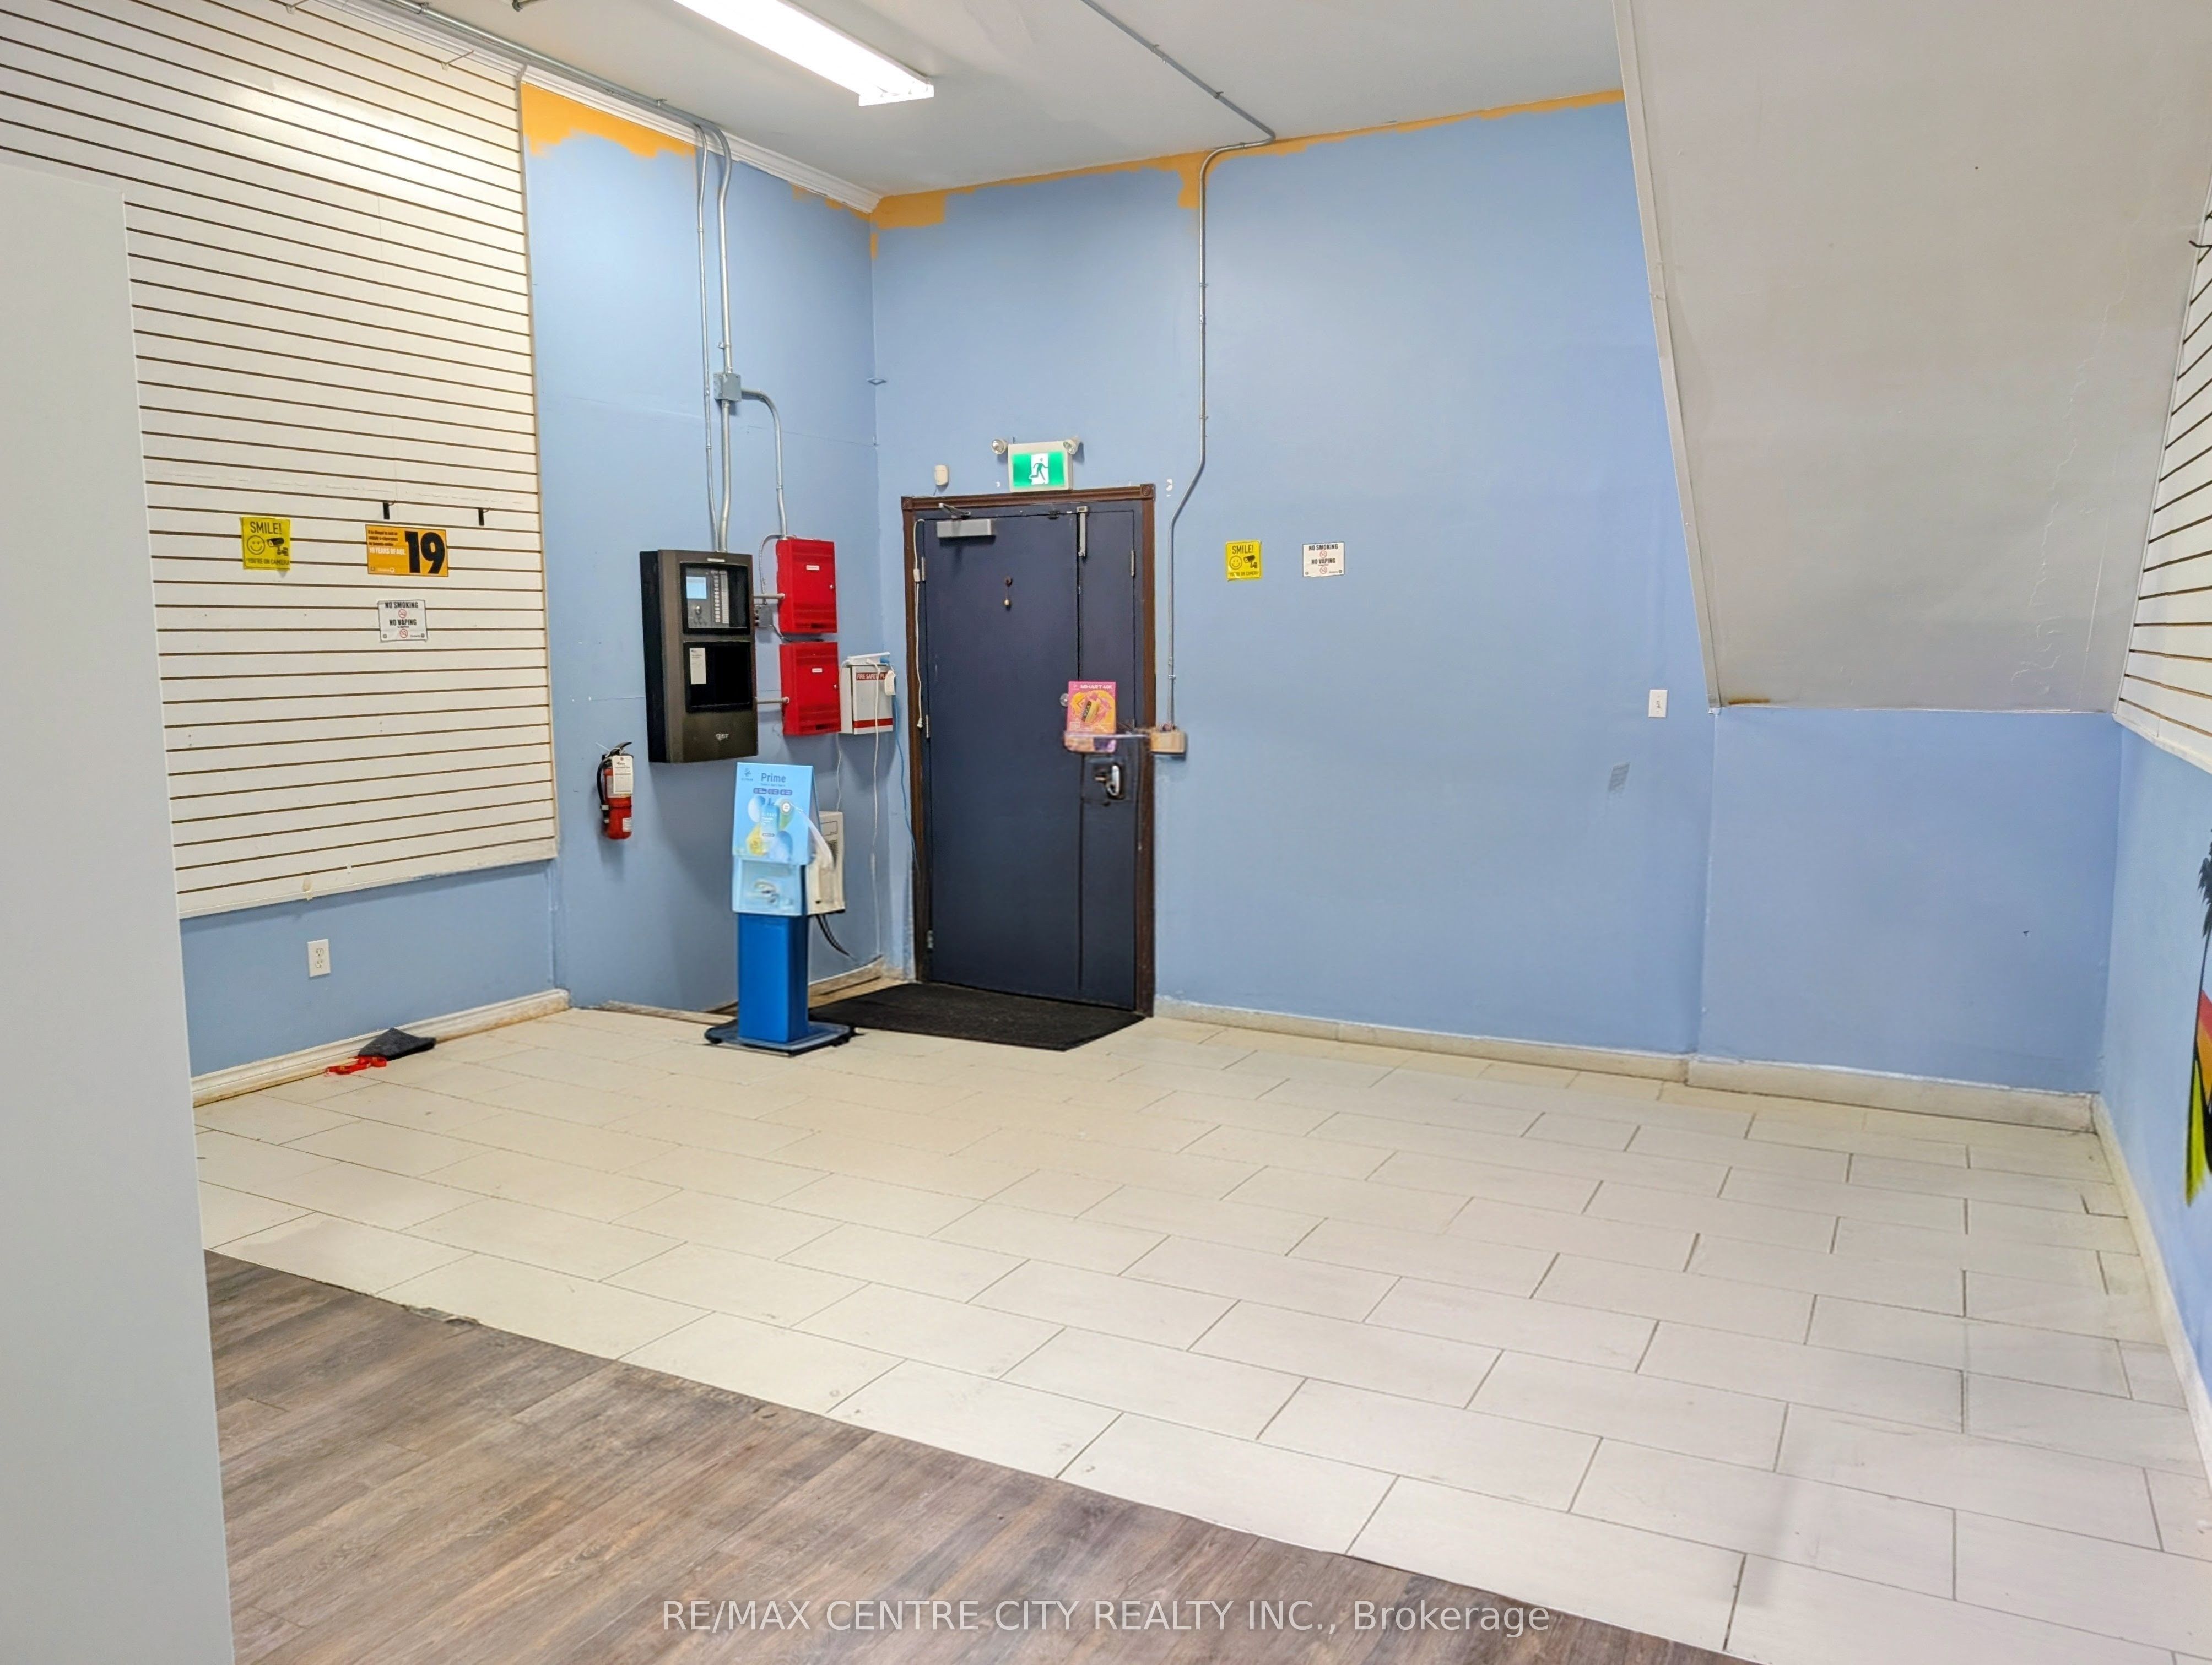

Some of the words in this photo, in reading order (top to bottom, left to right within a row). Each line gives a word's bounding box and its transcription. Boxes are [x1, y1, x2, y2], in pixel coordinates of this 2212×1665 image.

[250, 521, 282, 535] SMILE!
[404, 530, 445, 574] 19
[1232, 544, 1254, 554] SMILE!
[761, 773, 786, 783] Prime
